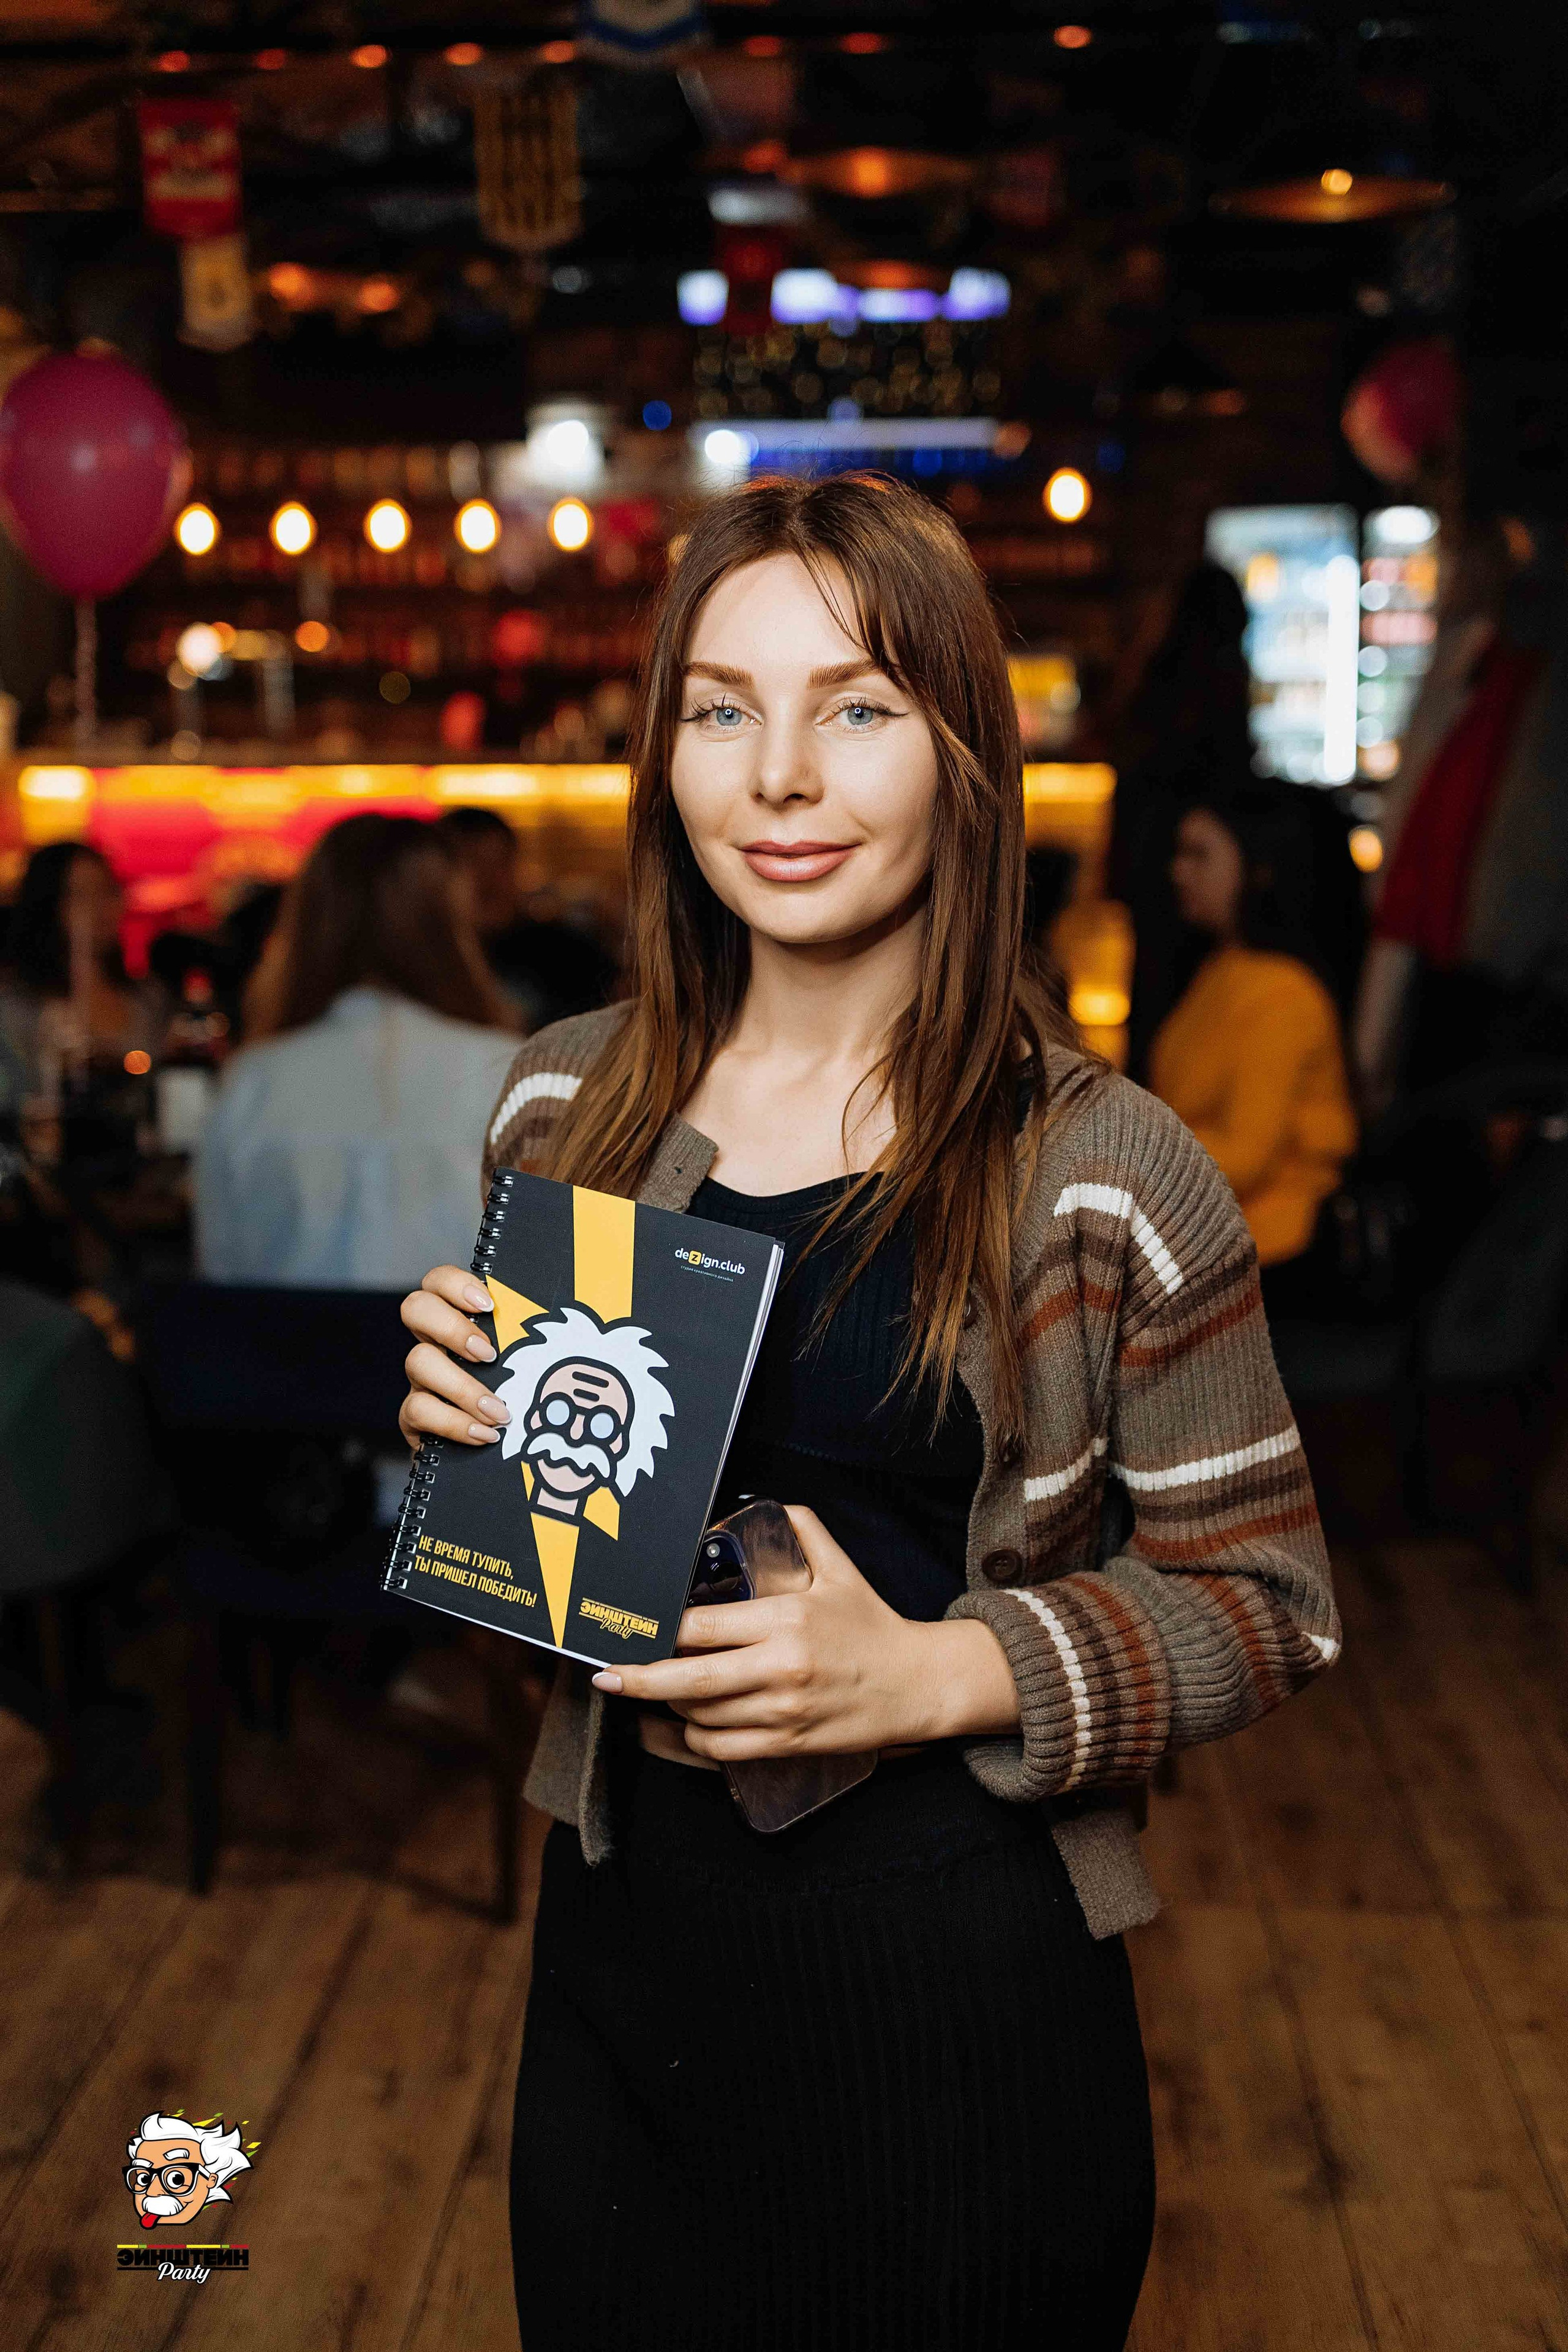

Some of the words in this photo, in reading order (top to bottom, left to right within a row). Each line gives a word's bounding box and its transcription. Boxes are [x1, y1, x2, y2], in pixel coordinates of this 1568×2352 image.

[674, 1248, 745, 1275] dezign.club
[418, 1534, 434, 1552] НЕ
[434, 1540, 470, 1564] ВРЕМЯ
[472, 1551, 514, 1580] ТУПИТЬ,
[415, 1555, 431, 1573] ТЫ
[431, 1561, 477, 1588] ПРИШЕЛ
[477, 1576, 537, 1607] ПОБЕДИТЬ!
[600, 1618, 633, 1639] Party
